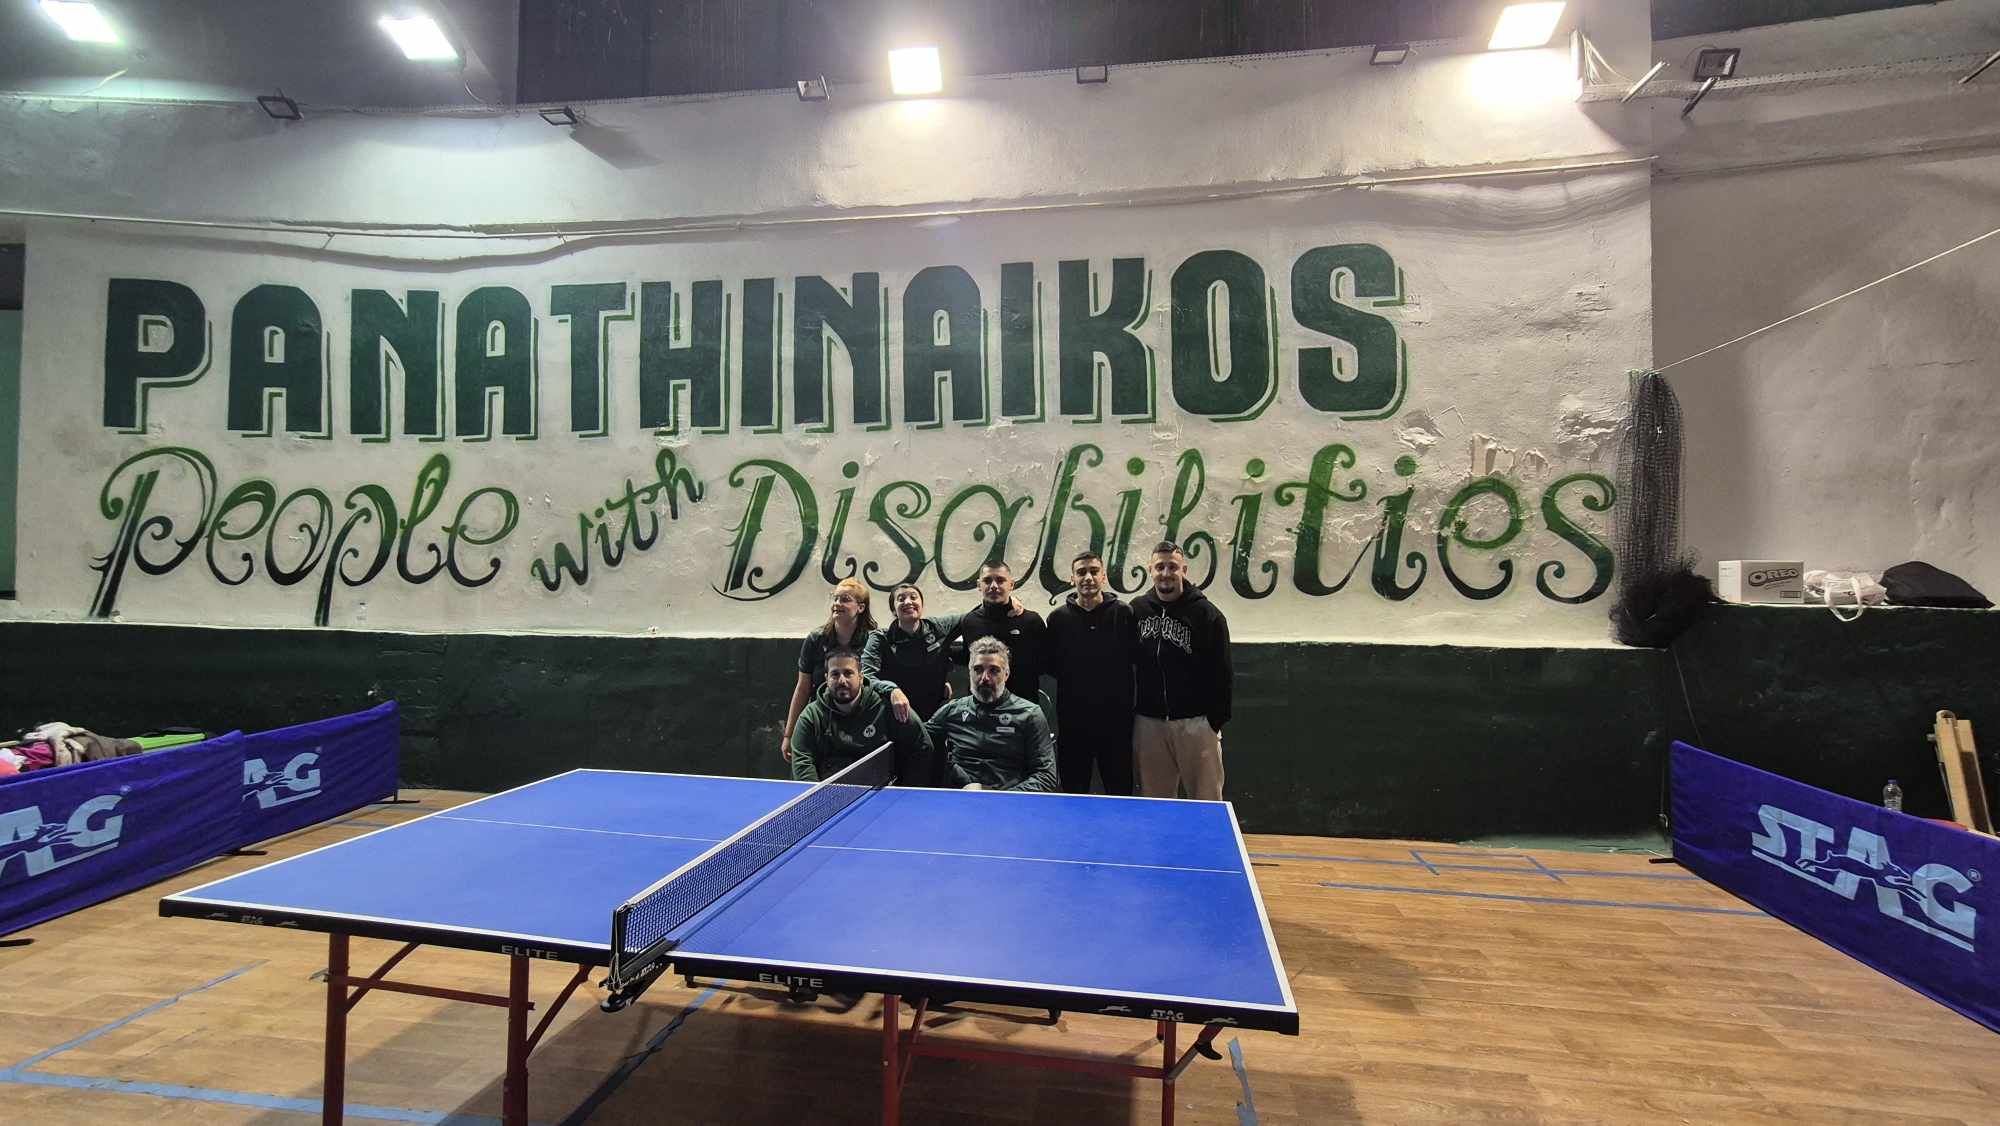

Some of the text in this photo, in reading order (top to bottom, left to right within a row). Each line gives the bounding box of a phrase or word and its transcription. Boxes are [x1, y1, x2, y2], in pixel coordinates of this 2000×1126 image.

[104, 244, 1405, 442] PANATHINAIKOS
[90, 443, 1616, 627] People with Disabilities
[1749, 568, 1799, 587] OREO
[1751, 804, 1977, 952] STAG
[501, 944, 560, 960] ELITE
[759, 972, 824, 988] ELITE
[1150, 1009, 1185, 1021] STAG
